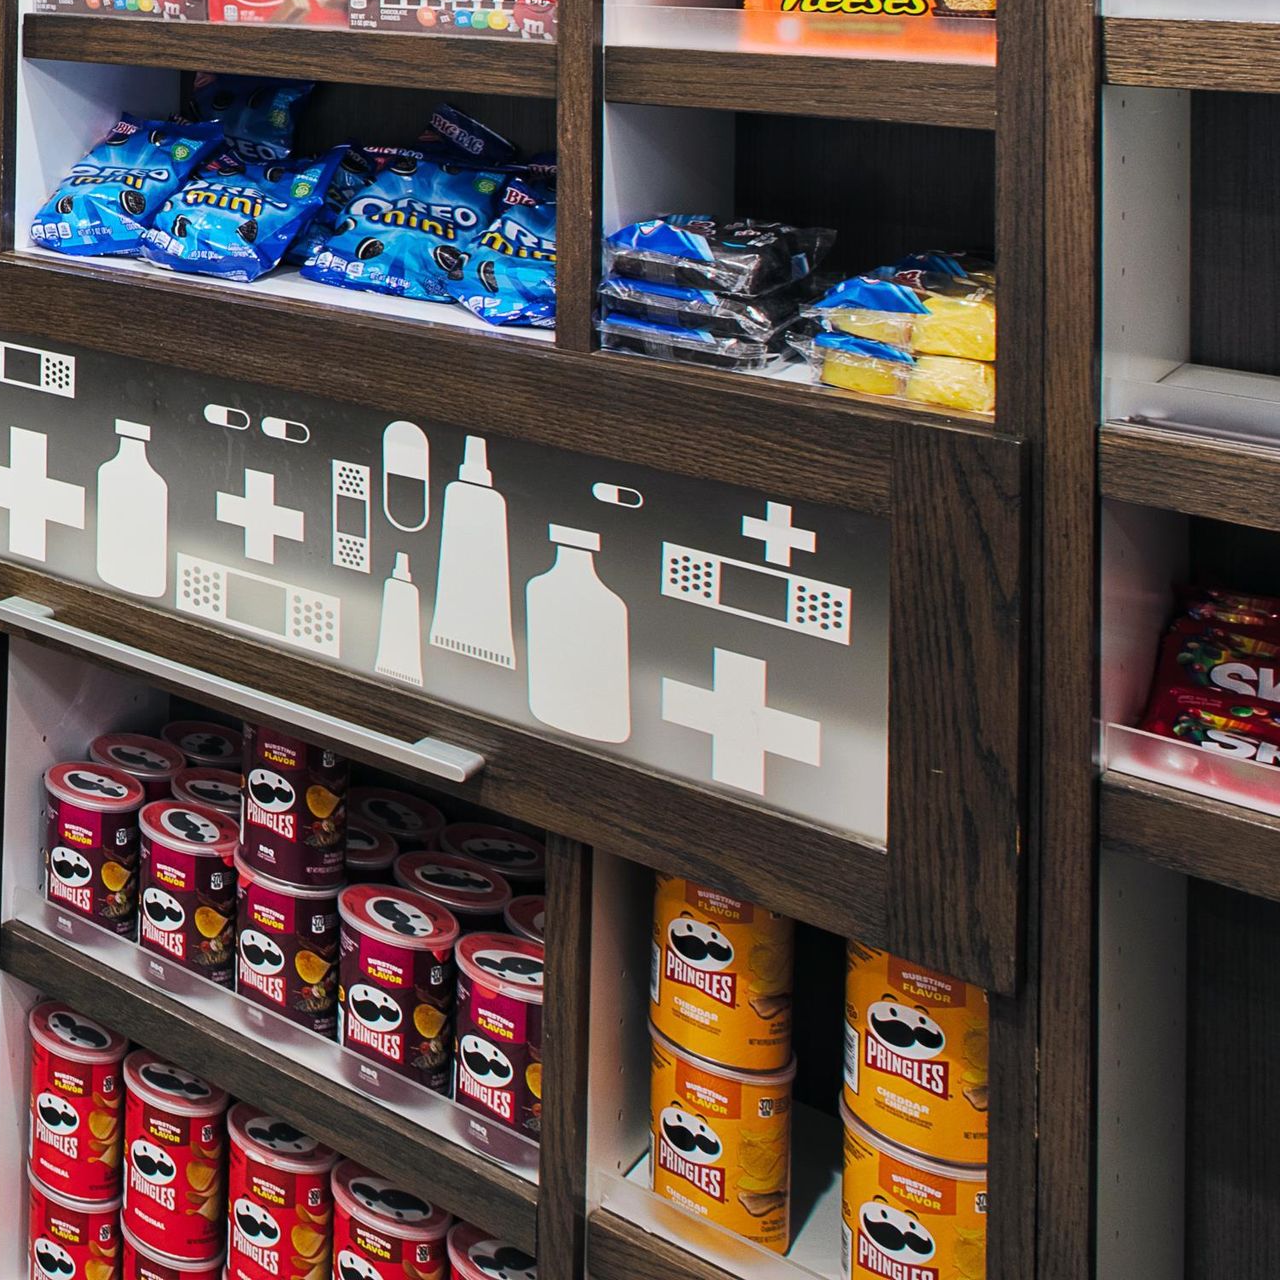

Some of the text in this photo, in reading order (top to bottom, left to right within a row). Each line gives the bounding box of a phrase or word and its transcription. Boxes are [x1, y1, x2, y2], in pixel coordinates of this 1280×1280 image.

[186, 188, 264, 218] mini
[368, 966, 403, 986] FLAVOR
[902, 982, 953, 1004] FLAVOR
[347, 1019, 402, 1061] PRINGLES
[866, 1037, 946, 1096] PRINGLES
[130, 1172, 176, 1212] PRINGLES
